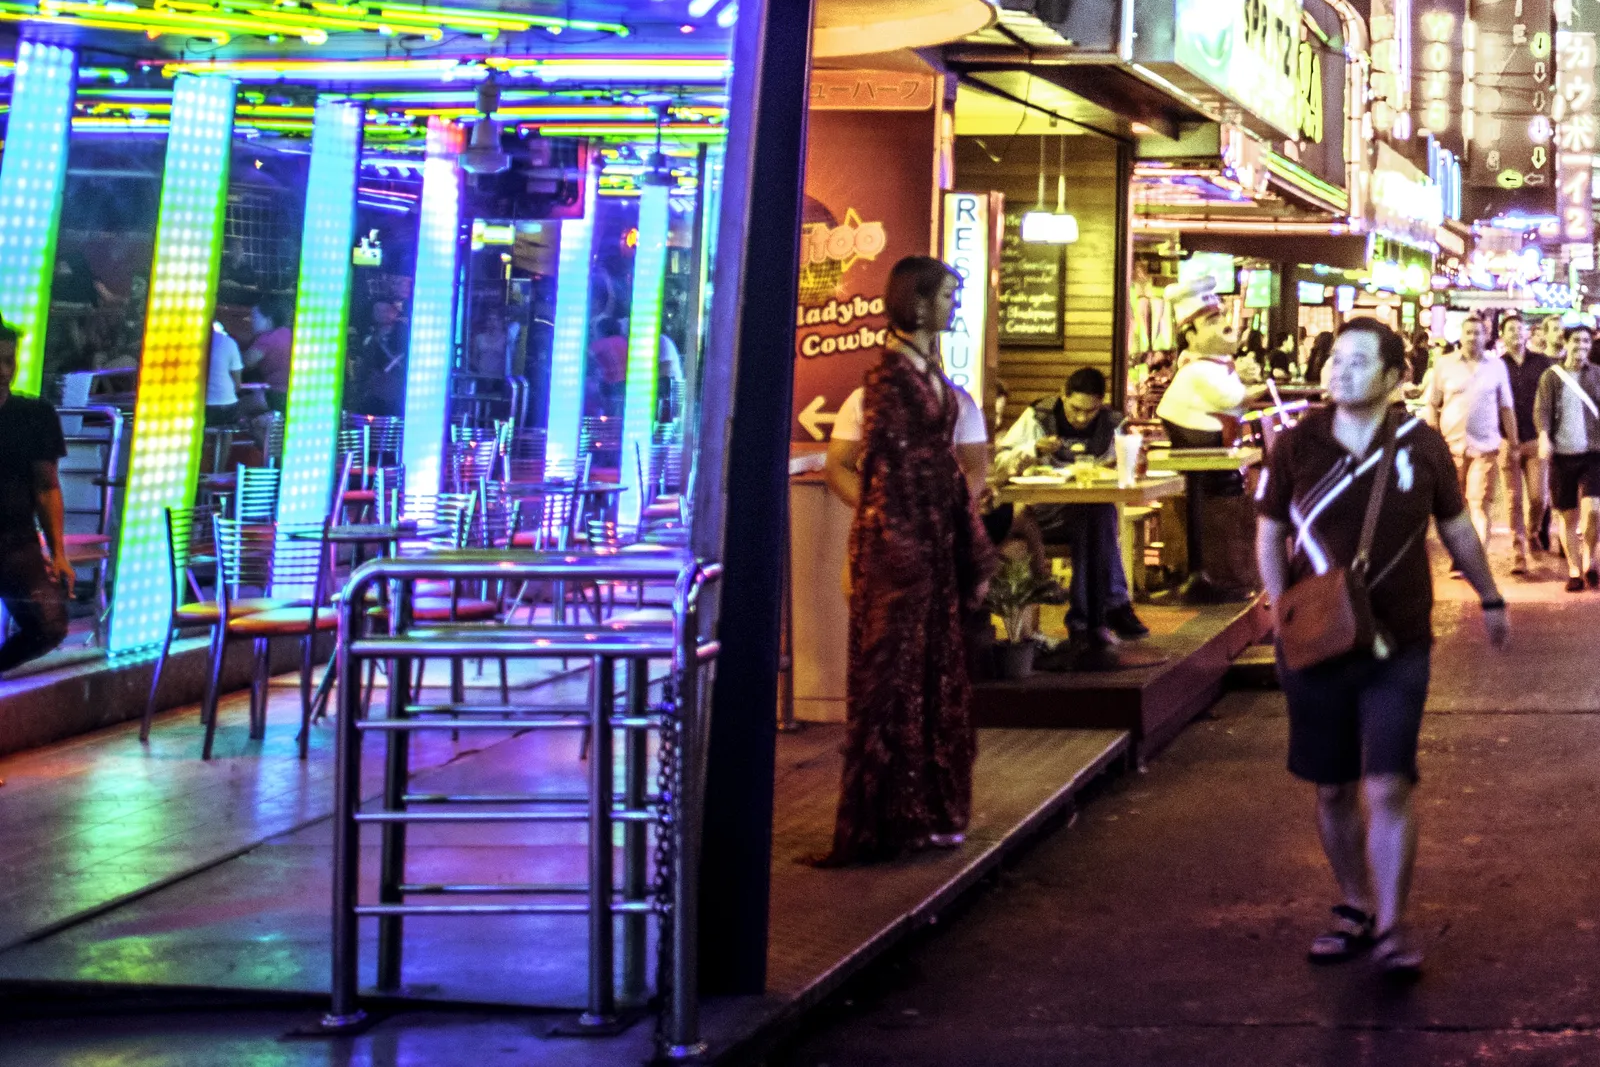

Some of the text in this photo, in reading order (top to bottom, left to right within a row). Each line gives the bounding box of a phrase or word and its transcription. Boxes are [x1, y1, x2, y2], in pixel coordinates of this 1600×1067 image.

[811, 80, 920, 100] ューハーフ
[950, 197, 977, 389] RESAU
[797, 296, 885, 326] ladybo
[802, 327, 887, 357] Cowbo
